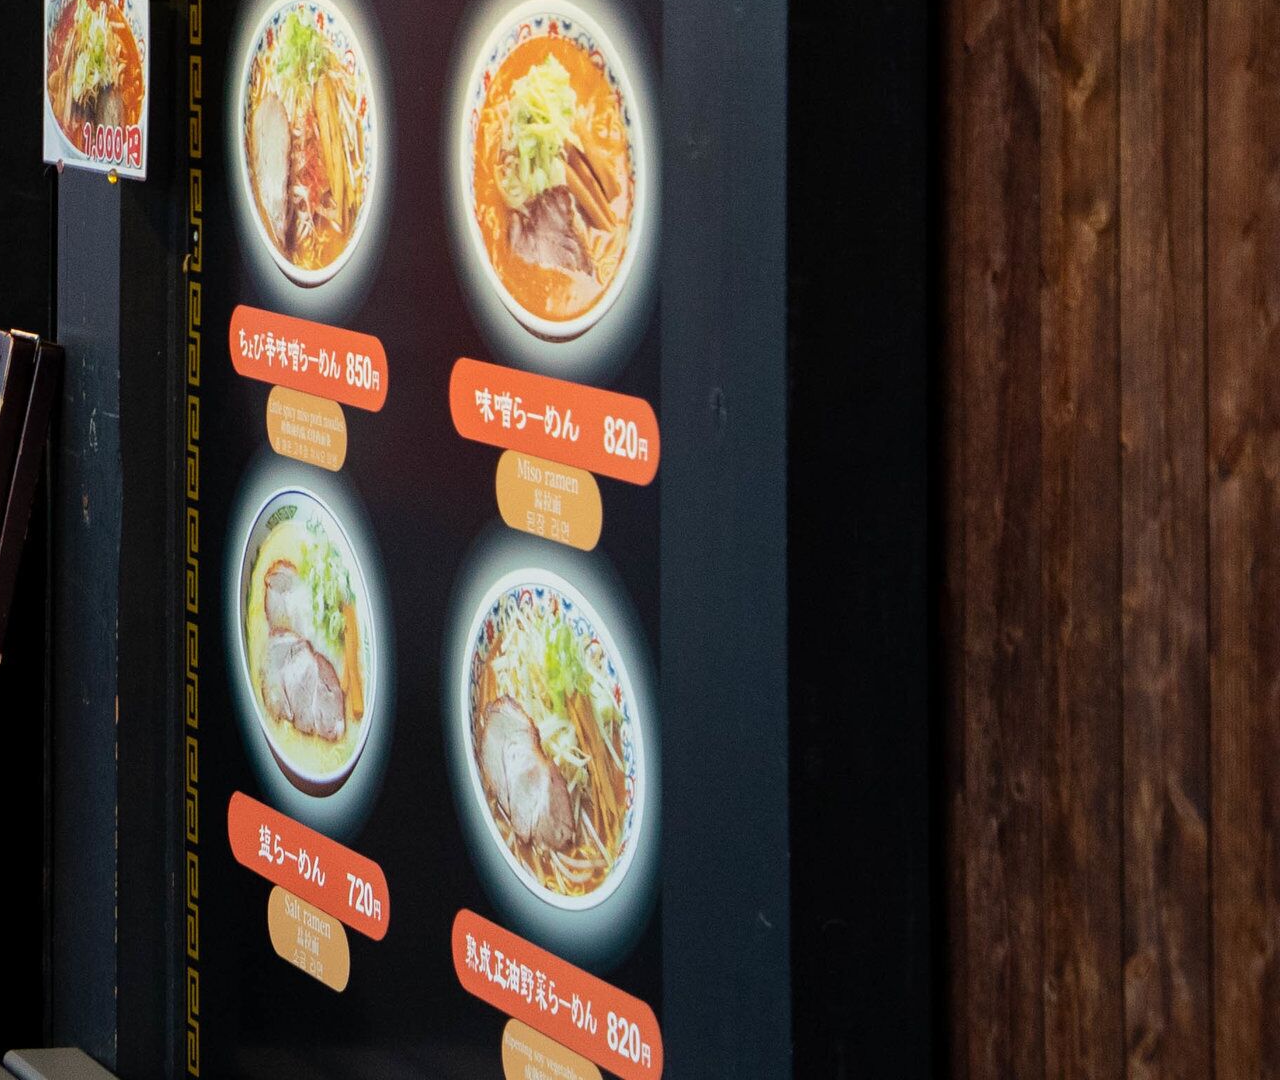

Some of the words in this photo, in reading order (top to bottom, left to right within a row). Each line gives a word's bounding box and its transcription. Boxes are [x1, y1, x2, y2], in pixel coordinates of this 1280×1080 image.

[345, 351, 381, 391] 850円
[474, 387, 580, 443] 味噌らーめん
[603, 415, 649, 462] 820円
[517, 457, 542, 484] Miso
[544, 471, 579, 495] ramen
[257, 824, 326, 888] 塩らーめん
[346, 872, 382, 921] 720円
[284, 894, 301, 921] Salt
[303, 910, 331, 940] ramen
[464, 932, 598, 1035] 熟成正油野菜らーめん
[605, 1012, 652, 1069] 820円
